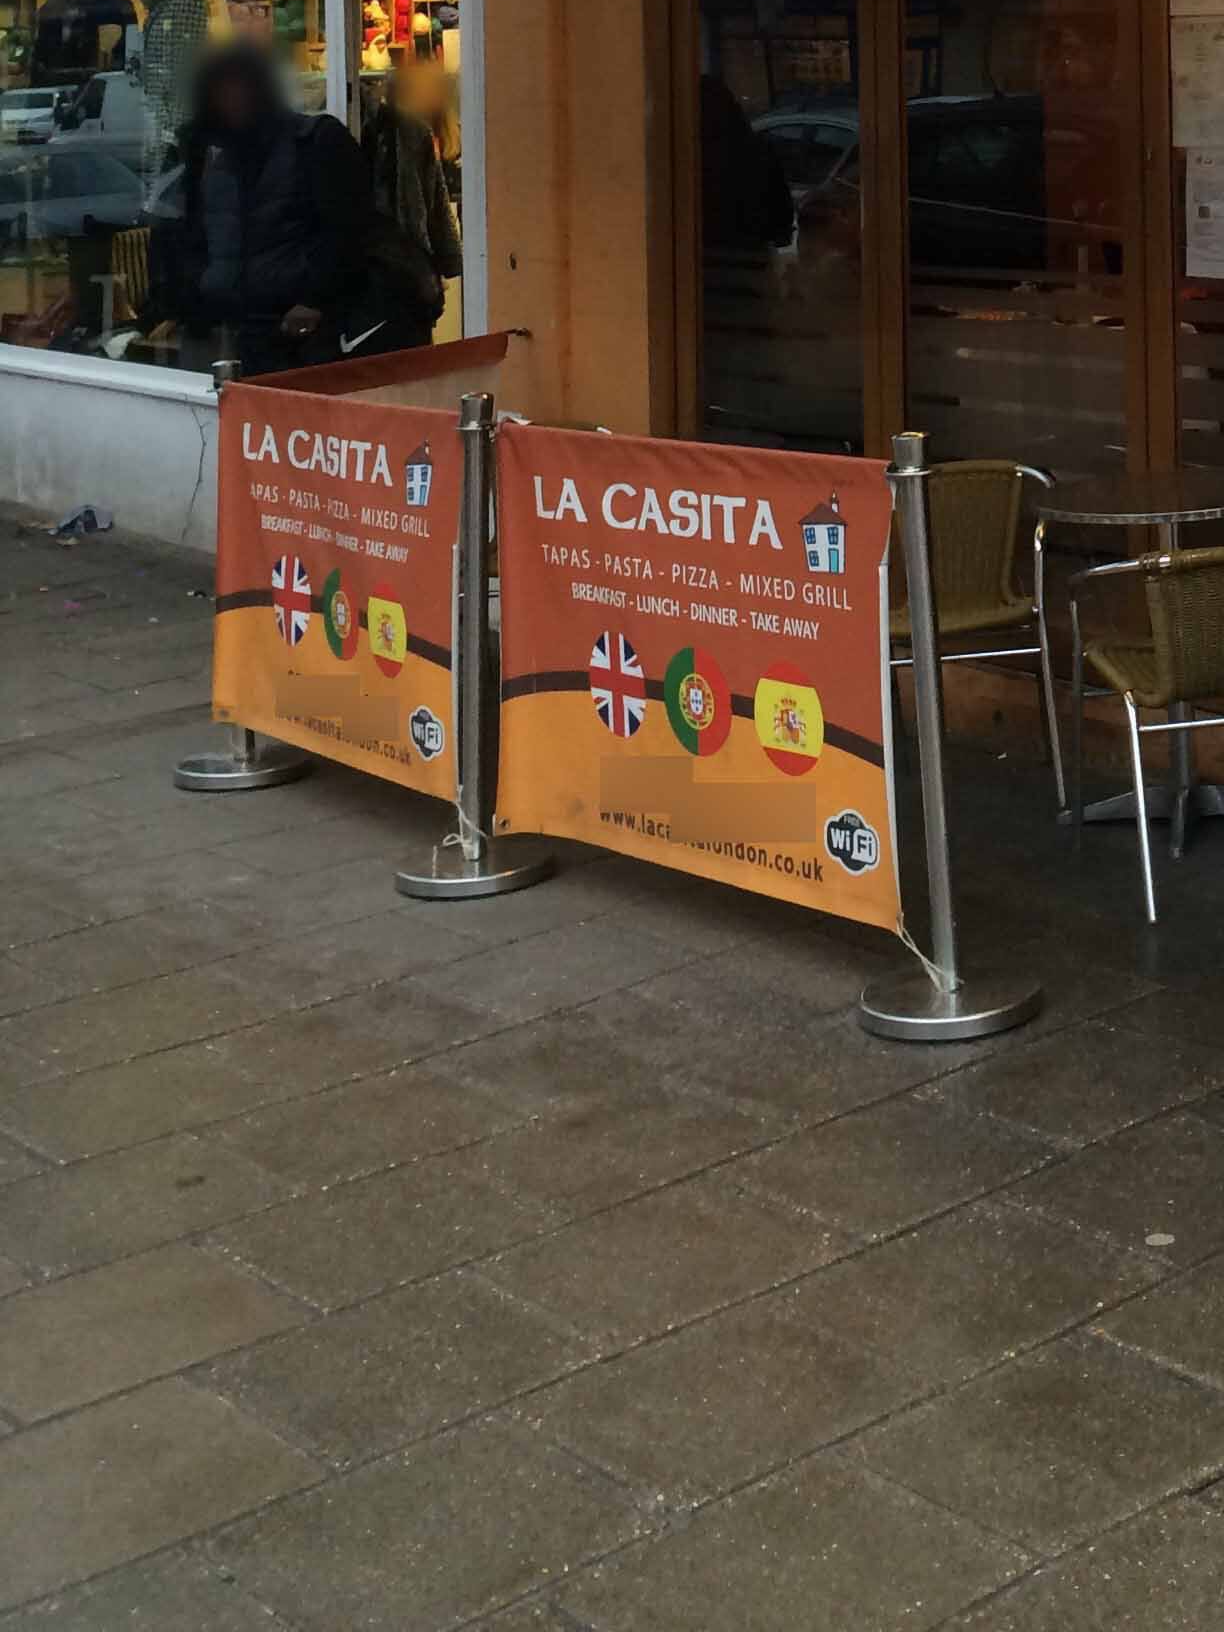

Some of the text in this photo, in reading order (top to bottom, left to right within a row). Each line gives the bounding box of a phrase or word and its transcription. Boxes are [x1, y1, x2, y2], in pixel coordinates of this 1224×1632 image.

[242, 422, 394, 487] LA CASITA
[289, 488, 321, 514] PASTA
[360, 506, 399, 531] MIXED
[401, 513, 431, 538] GRILL
[533, 475, 783, 551] LA CASITA
[541, 543, 853, 611] TAPAS PASTA PIZZA MIXED GRILL
[571, 581, 820, 641] BREAKFAST LUNCH DINNER TAKE AWAY
